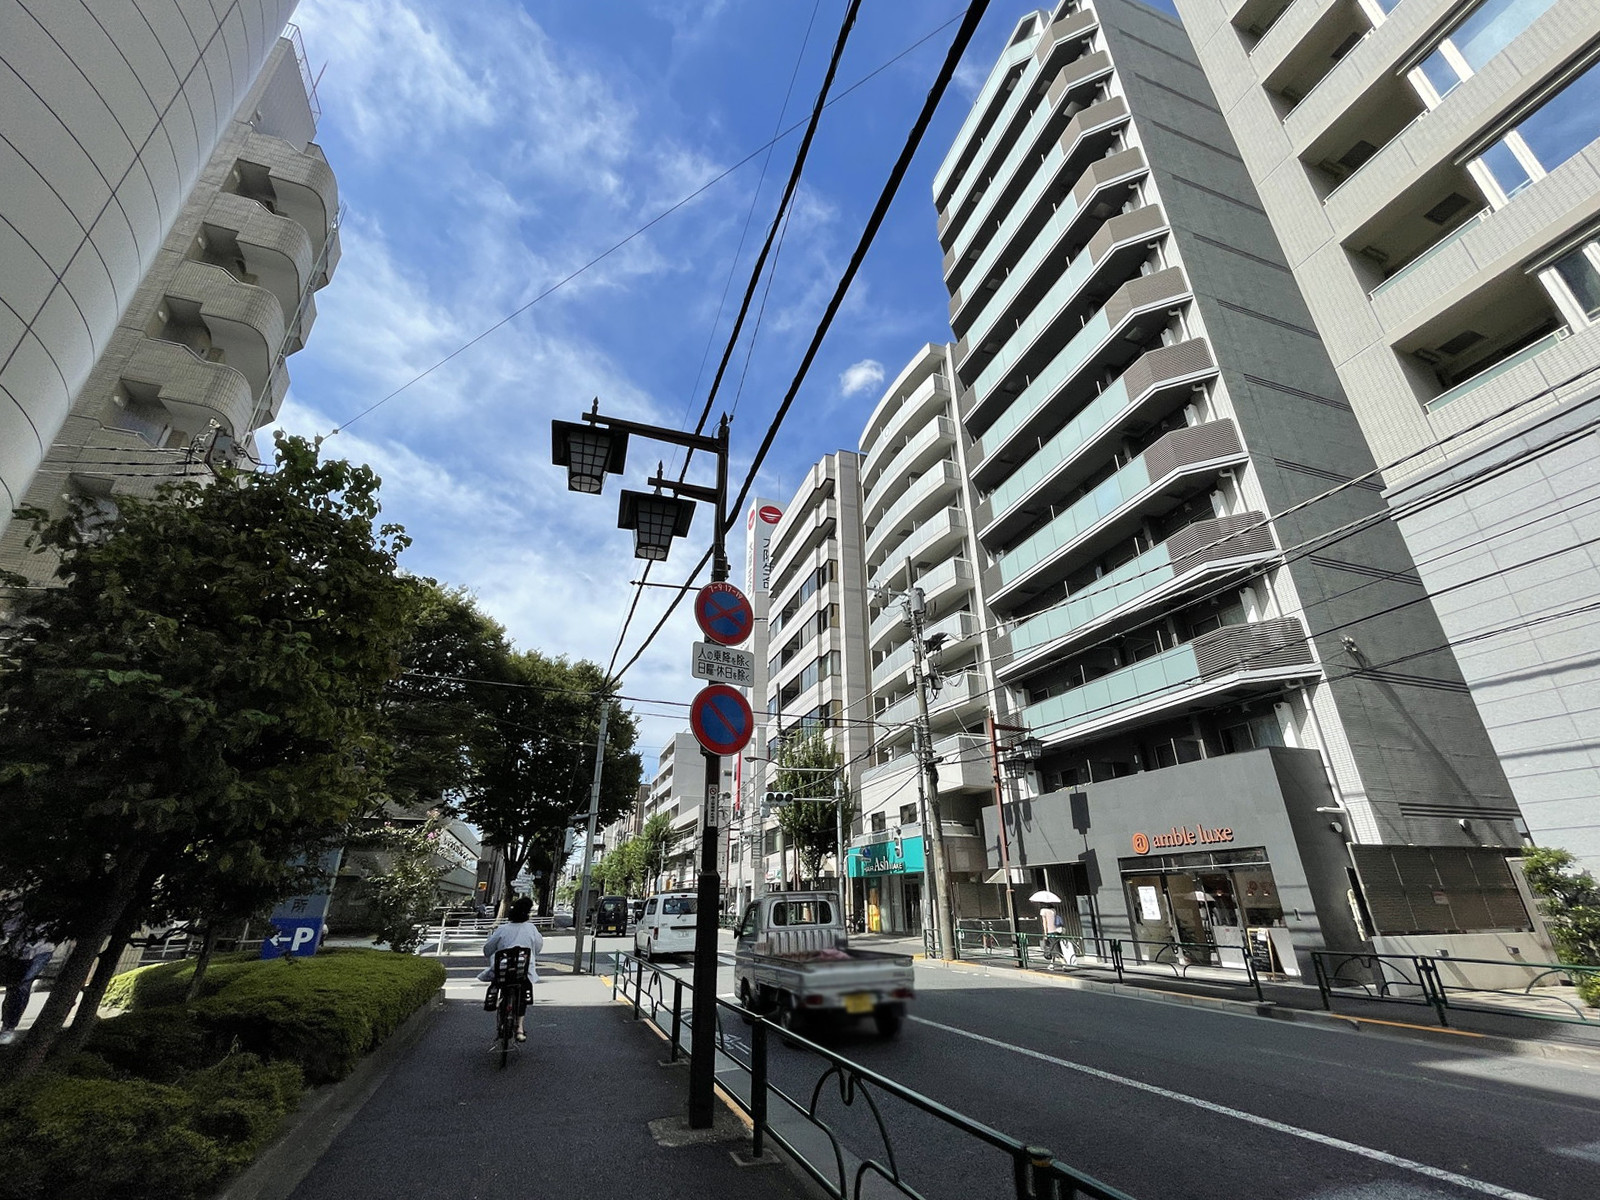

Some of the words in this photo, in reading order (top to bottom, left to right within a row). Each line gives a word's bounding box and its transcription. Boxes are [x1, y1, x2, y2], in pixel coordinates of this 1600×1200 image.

[698, 648, 749, 667] 人の乗降を除く
[1153, 827, 1196, 849] amble
[1197, 824, 1234, 845] luxe
[874, 855, 889, 872] Ash
[291, 927, 315, 951] P
